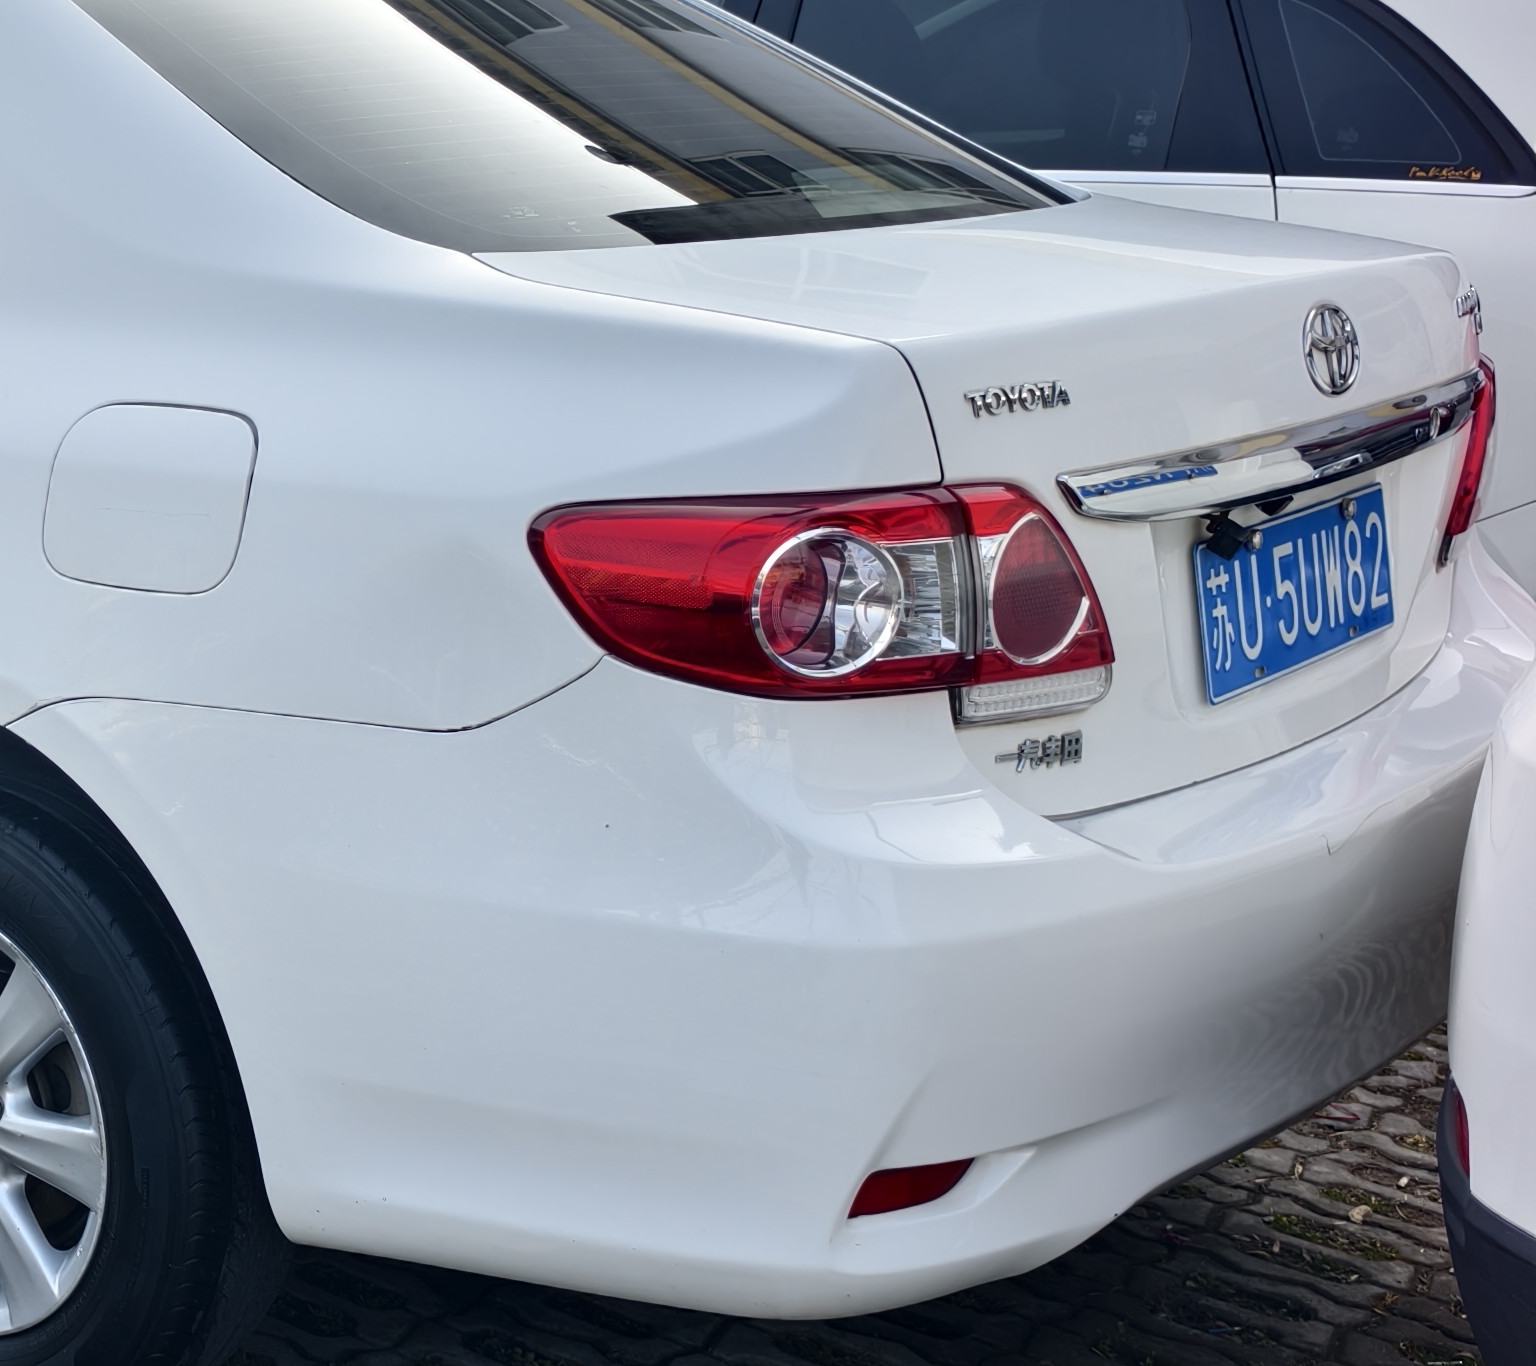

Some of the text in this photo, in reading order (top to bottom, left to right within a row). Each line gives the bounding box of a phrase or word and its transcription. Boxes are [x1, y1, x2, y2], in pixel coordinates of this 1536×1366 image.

[964, 379, 1071, 419] TOYOTA
[995, 729, 1083, 773] 一汽丰田
